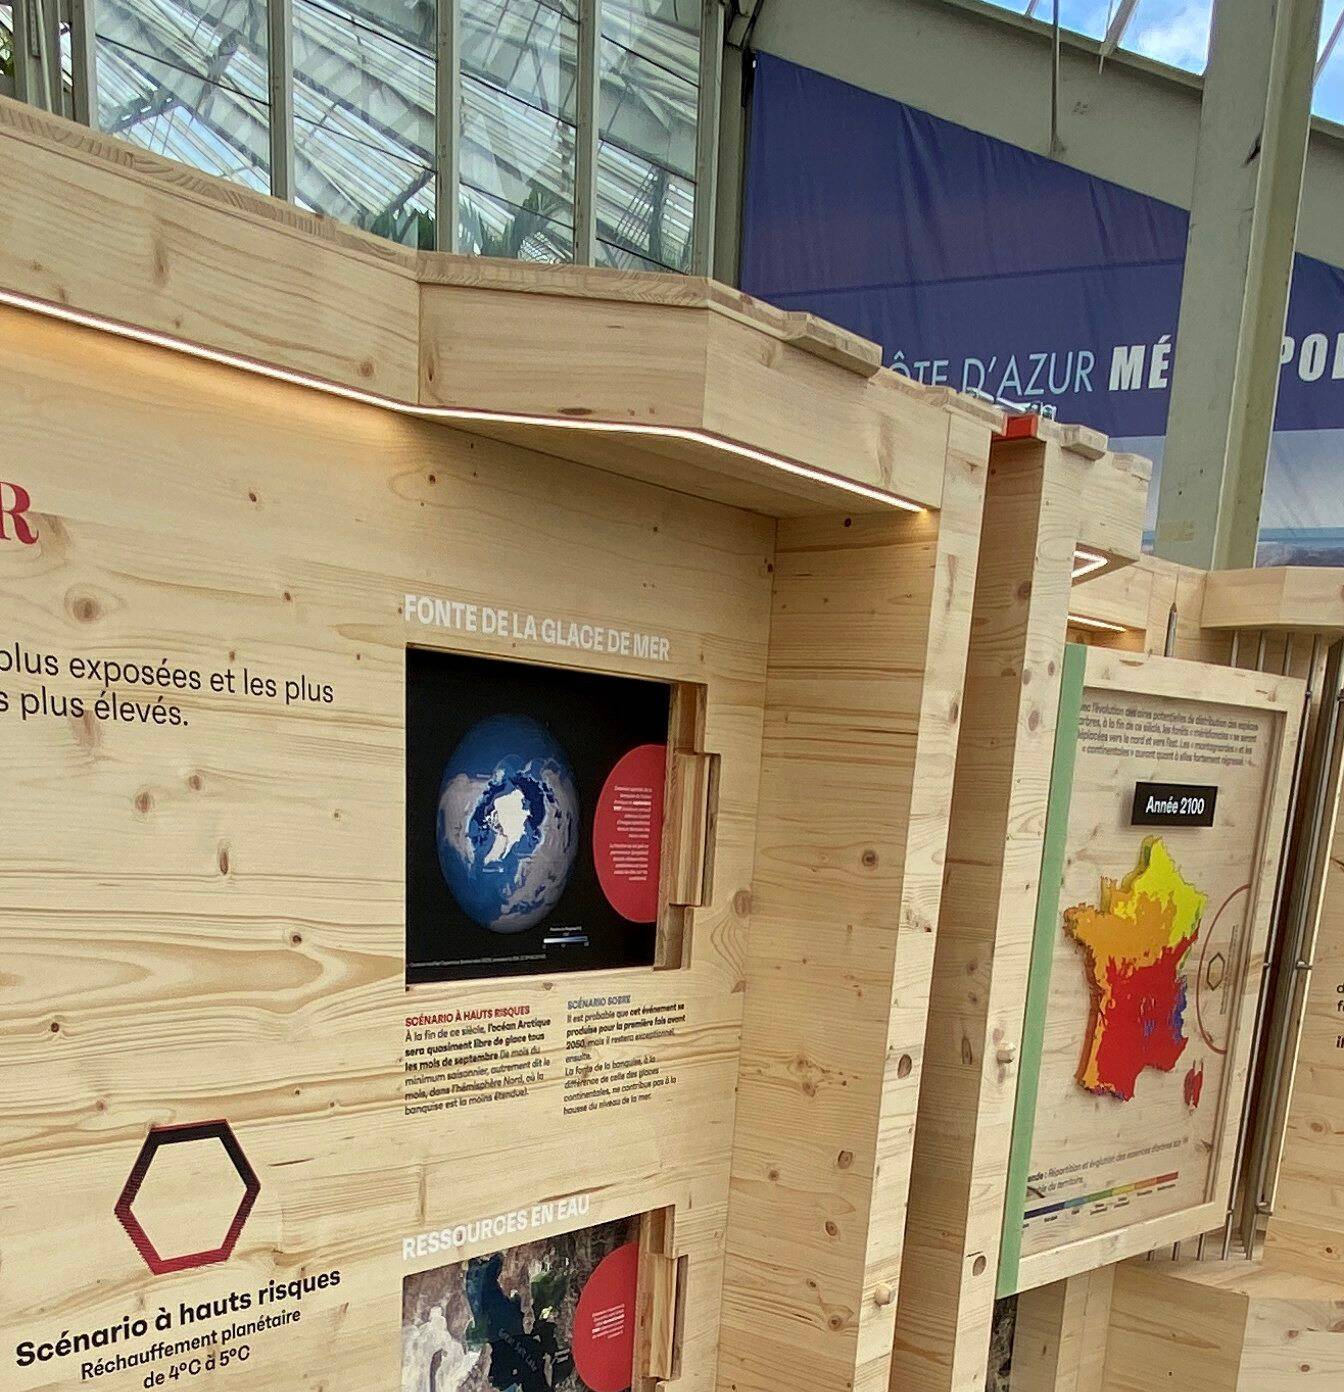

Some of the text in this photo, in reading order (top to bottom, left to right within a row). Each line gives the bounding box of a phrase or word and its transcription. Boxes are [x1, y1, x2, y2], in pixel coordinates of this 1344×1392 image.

[960, 350, 1096, 398] D'AZUR
[403, 594, 671, 662] FONTE DE LA GLACE DE MER
[20, 685, 85, 721] plus
[94, 691, 190, 726] élevés.
[69, 657, 202, 690] exposées
[209, 668, 236, 694] et
[243, 667, 277, 698] les
[285, 674, 334, 706] plus
[1145, 795, 1205, 816] Année 2100
[402, 1194, 591, 1260] RESSOURCES EN EAU
[15, 1270, 341, 1367] Scénario à hauts risques
[81, 1309, 301, 1381] Réchauffement planétaire
